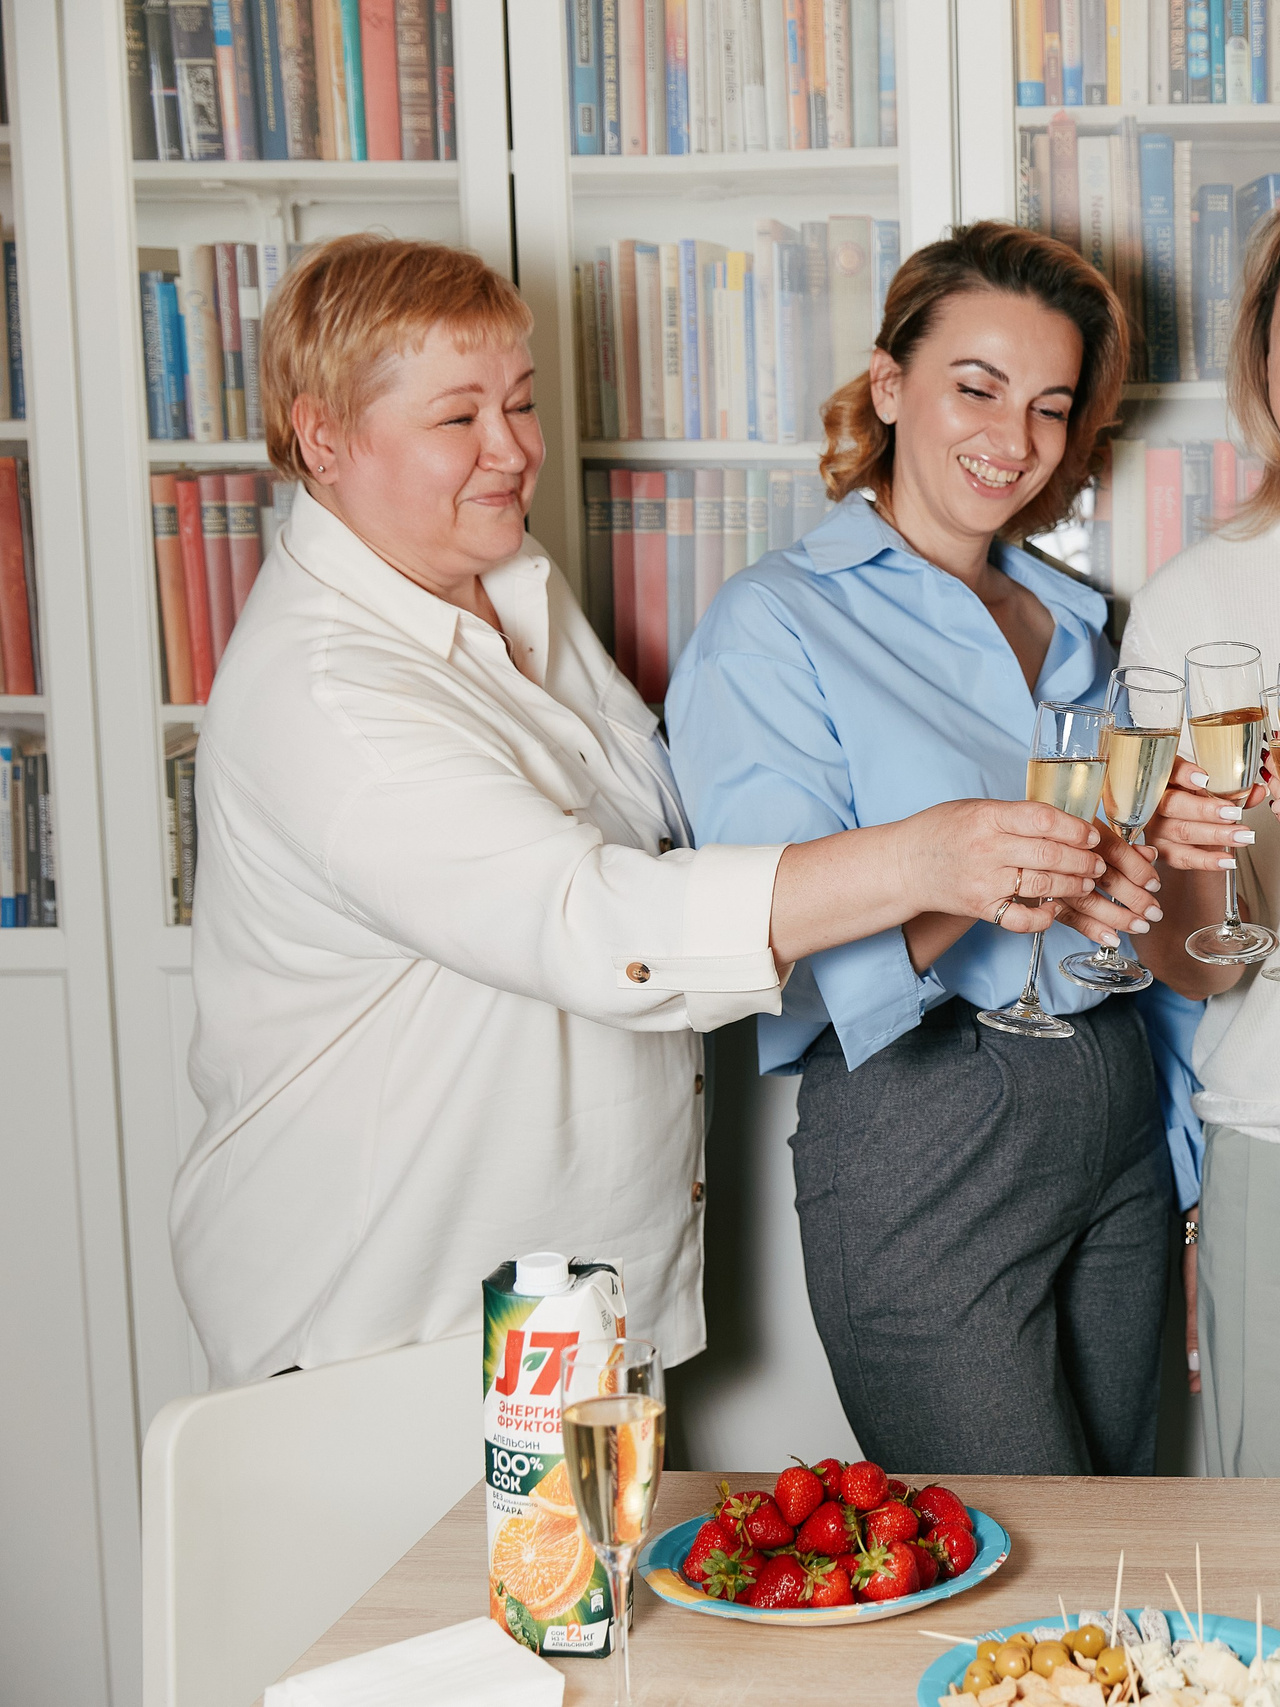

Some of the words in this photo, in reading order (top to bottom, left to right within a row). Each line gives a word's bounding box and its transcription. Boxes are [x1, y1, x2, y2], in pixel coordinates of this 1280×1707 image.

[1156, 226, 1175, 364] SHAKESPEARE
[495, 1329, 580, 1396] J7
[493, 1433, 540, 1450] АПЕЛЬСИН
[492, 1448, 544, 1477] 100%
[492, 1471, 521, 1492] СОК
[493, 1491, 503, 1501] БЕЗ
[493, 1501, 523, 1516] САХАРА
[568, 1624, 580, 1640] 2
